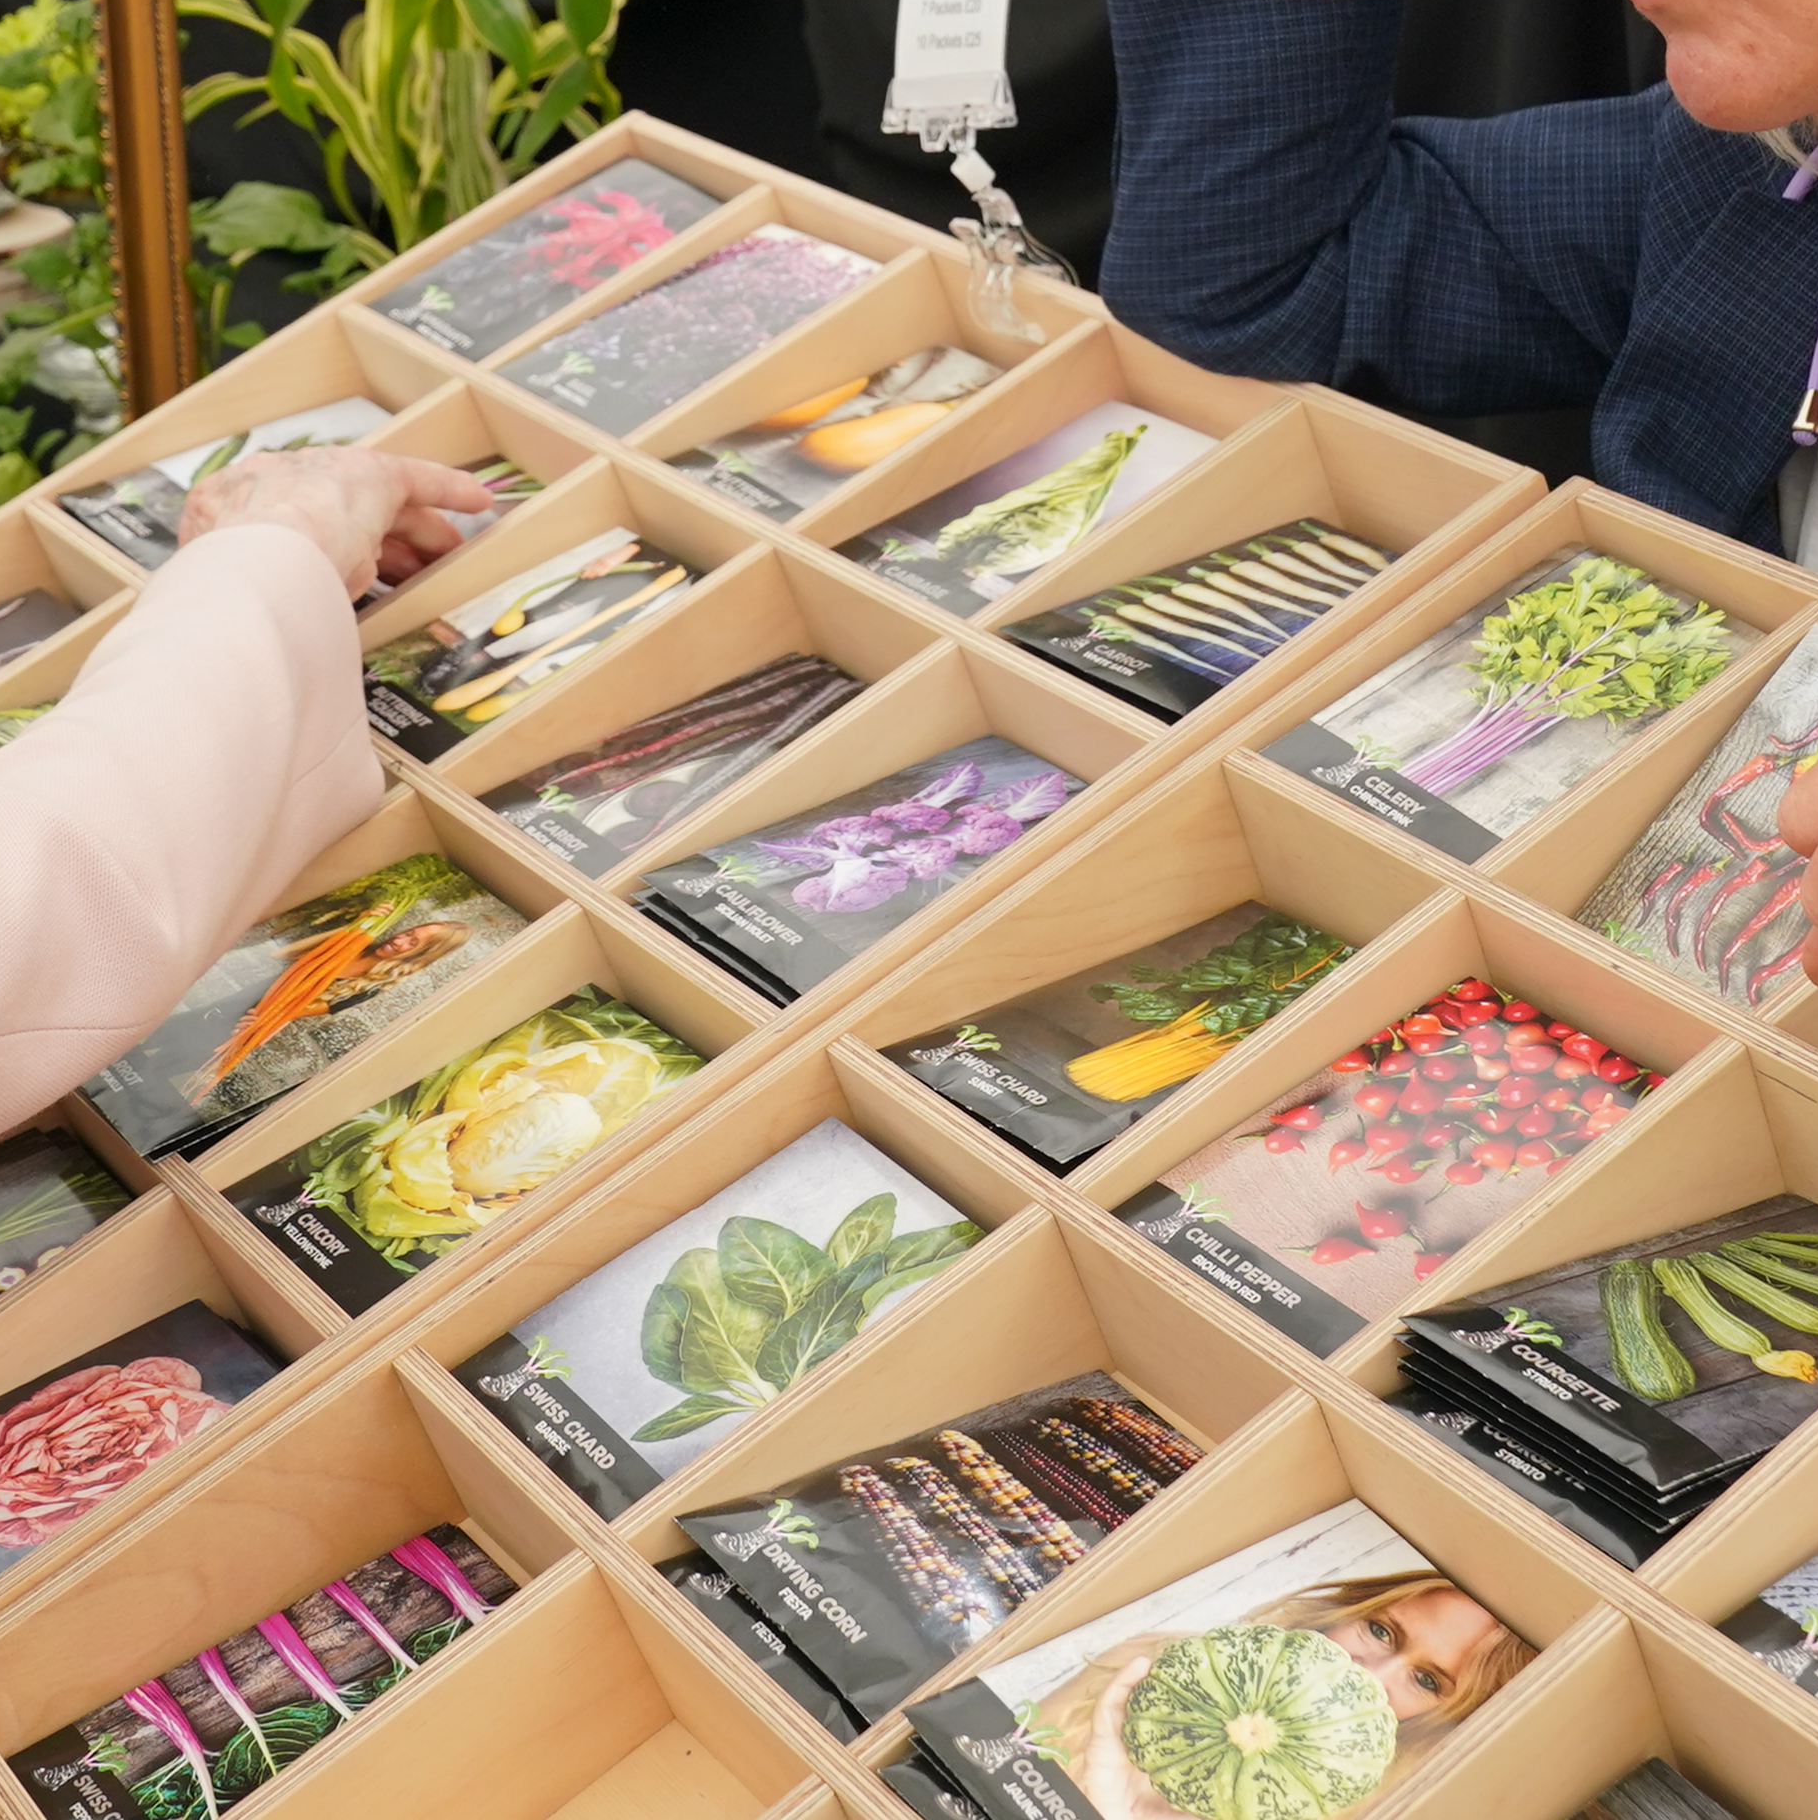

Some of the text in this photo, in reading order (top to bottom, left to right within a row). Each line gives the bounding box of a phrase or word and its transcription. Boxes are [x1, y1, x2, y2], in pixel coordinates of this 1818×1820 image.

[929, 0, 963, 15] Packets
[928, 33, 963, 49] Packets
[964, 31, 982, 48] £25
[1082, 650, 1137, 677] WHITE SATIN
[1094, 644, 1153, 671] CARROT
[368, 697, 413, 729] SQUASH
[371, 685, 434, 727] BUTTERNUT
[1349, 784, 1414, 828] CHINESE PINK
[1364, 775, 1427, 815] CELERY
[523, 825, 552, 846] BLACK
[540, 819, 589, 852] CARROT
[715, 883, 804, 946] CAULIFLOWER
[744, 922, 775, 944] VIOLET
[954, 1051, 1048, 1106] SWISS CHARD
[967, 1076, 1004, 1098] SUNSET
[282, 1222, 334, 1270] YELLOWSTONE
[297, 1213, 350, 1257] CHICORY
[1185, 1227, 1302, 1309] CHILLI PEPPER
[1191, 1253, 1262, 1304] BIQUINHO RED
[1511, 1343, 1622, 1413] COURGETTE
[1522, 1367, 1573, 1401] STRIATO
[523, 1382, 616, 1469] SWISS CHARD
[534, 1420, 572, 1456] BARESE
[1494, 1448, 1547, 1481] STRIATO
[762, 1542, 824, 1600] DRYING
[817, 1596, 869, 1644] CORN
[778, 1586, 814, 1622] FIESTA
[751, 1620, 787, 1656] FIESTA
[73, 1774, 113, 1815] SWISS
[1011, 1759, 1080, 1820] COURG
